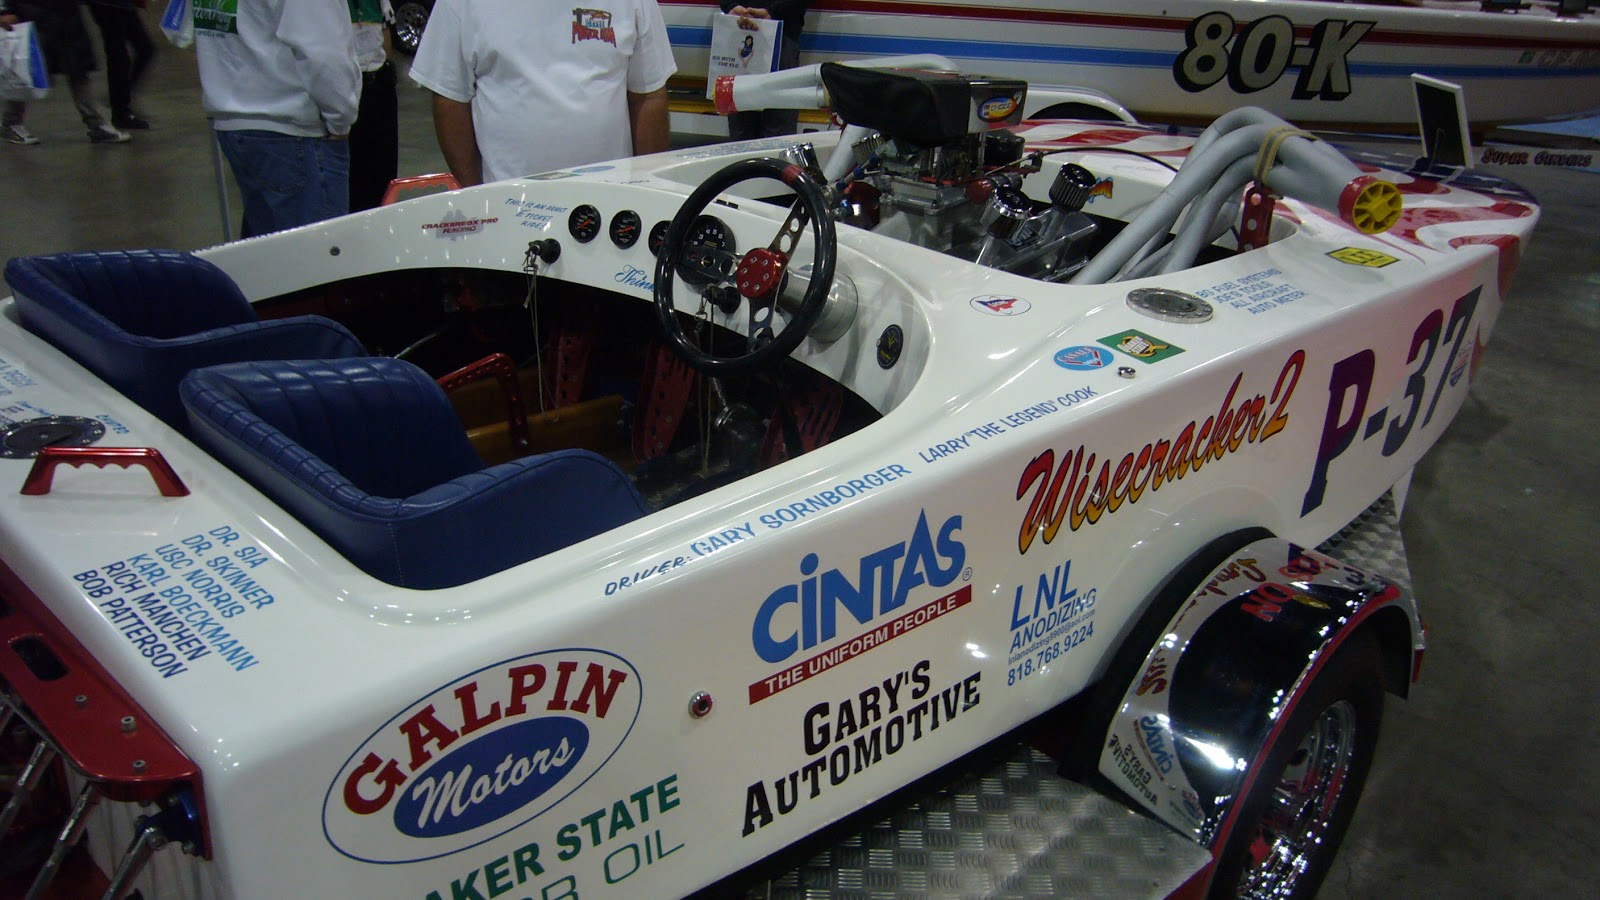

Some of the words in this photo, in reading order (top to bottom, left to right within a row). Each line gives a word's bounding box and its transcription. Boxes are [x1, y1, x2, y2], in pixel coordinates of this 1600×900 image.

[1173, 11, 1378, 101] 80-K
[1481, 148, 1529, 165] SUPER
[546, 205, 568, 213] ADULT
[1212, 281, 1241, 292] FUEL
[1230, 299, 1251, 309] ALL
[1248, 284, 1296, 302] AIRCRAFT
[1247, 301, 1277, 315] AUTO
[1272, 290, 1309, 305] METER
[1300, 284, 1484, 519] P-37
[604, 555, 693, 596] DRIVER:
[690, 522, 756, 557] GARY
[759, 464, 913, 529] SORNBORGER
[918, 434, 971, 463] LARRY
[1057, 385, 1099, 408] COOK
[155, 543, 194, 570] USC
[182, 568, 246, 619] NORRIS
[181, 534, 213, 557] DR.
[206, 555, 275, 610] SKINNER
[209, 525, 240, 548] DR.
[234, 545, 269, 569] SIA
[73, 569, 114, 599] BOB
[100, 597, 188, 679] PATTERSON
[101, 560, 147, 594] RICH
[132, 592, 212, 662] MANCHEN
[127, 553, 171, 587] KARL
[159, 585, 260, 672] BOECKMANN
[1009, 588, 1097, 655] ANODIZING
[1010, 559, 1078, 632] LNL
[765, 665, 804, 694] THE
[808, 627, 889, 674] UNIFORM
[893, 594, 957, 635] PEOPLE
[1007, 621, 1094, 687] 818.768.9224
[343, 661, 628, 815] GALPIN
[804, 660, 931, 756] GARY'S
[412, 737, 576, 829] Motors
[742, 671, 982, 838] AUTOMOTIVE
[556, 773, 681, 862] STATE
[603, 829, 686, 885] OIL
